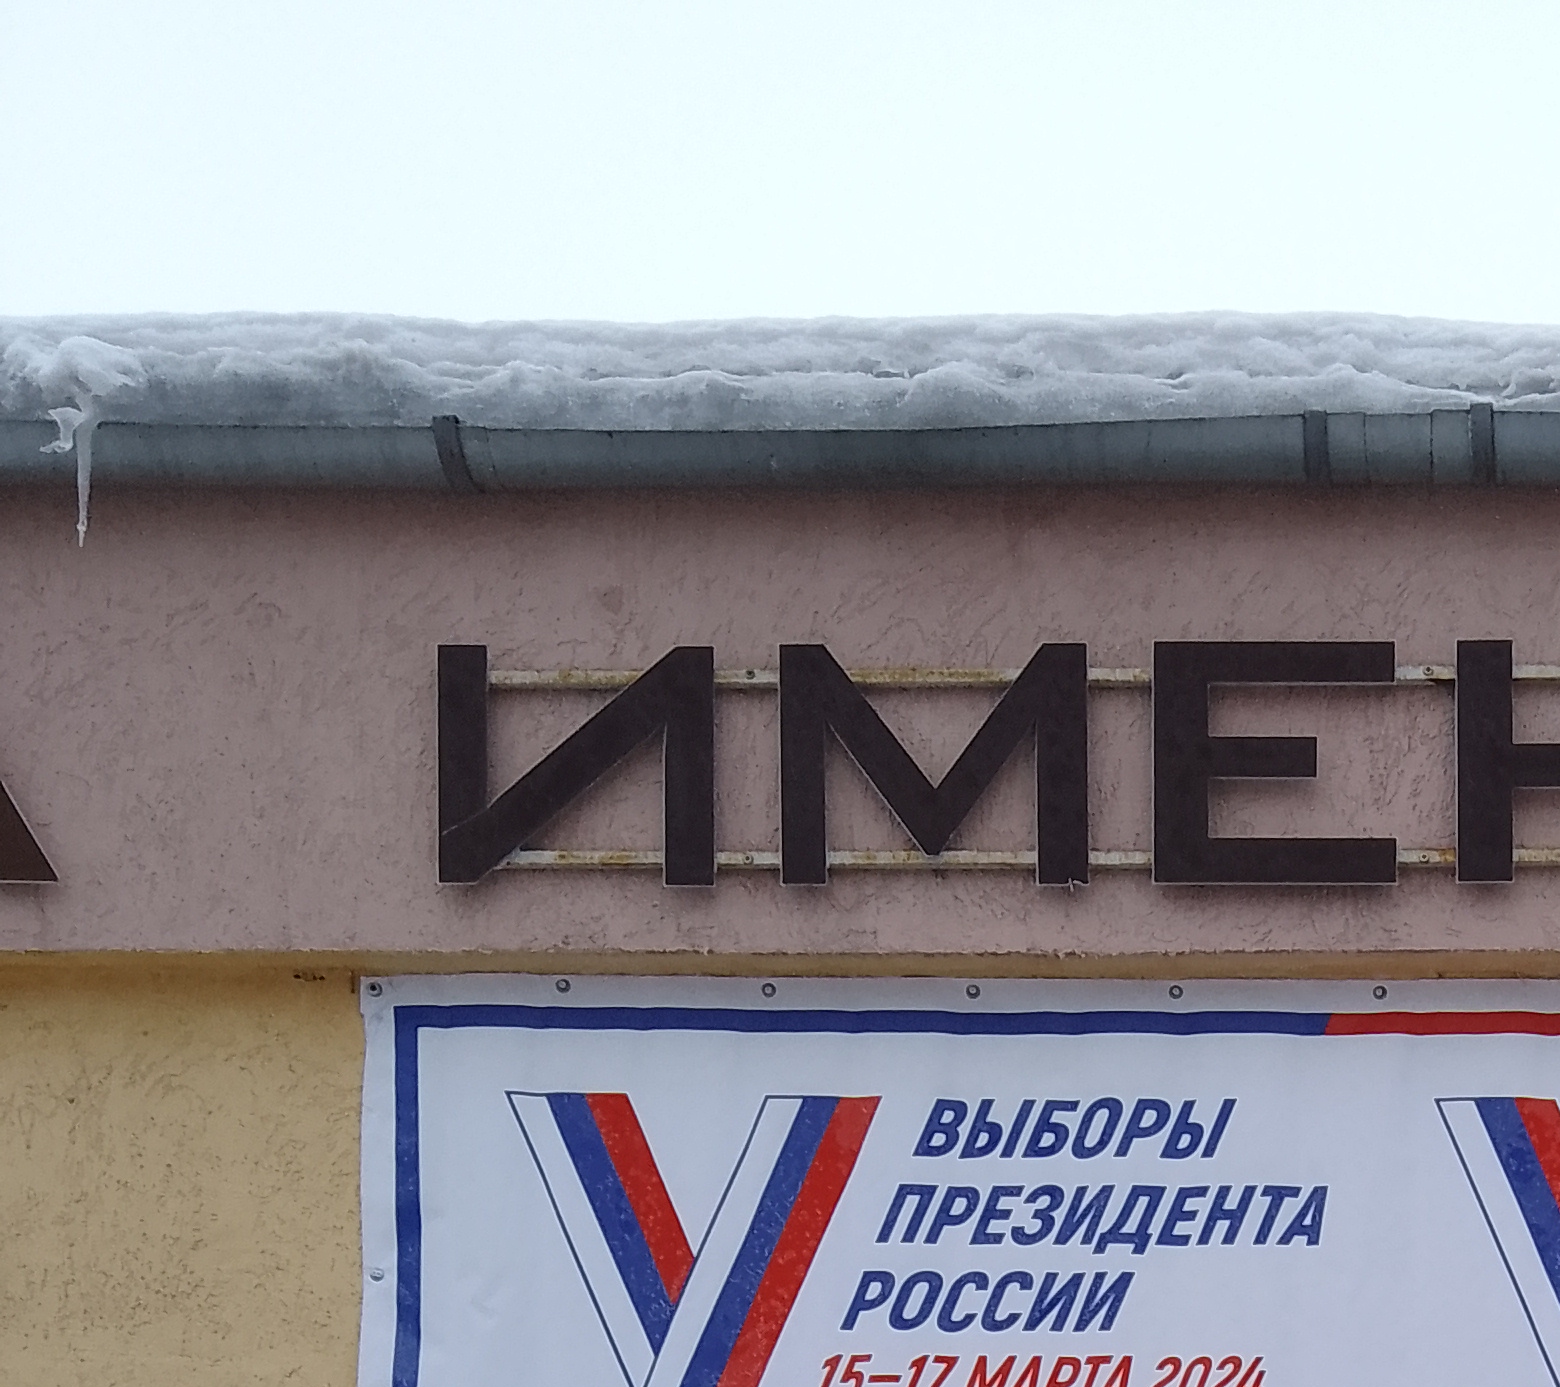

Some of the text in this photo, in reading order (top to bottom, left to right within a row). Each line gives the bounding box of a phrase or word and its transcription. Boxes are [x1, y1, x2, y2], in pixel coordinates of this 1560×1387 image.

[913, 1097, 1237, 1160] ВЫБОРЫ
[876, 1183, 1329, 1254] ПРЕЗИДЕНТА
[840, 1270, 1136, 1333] РОССИИ
